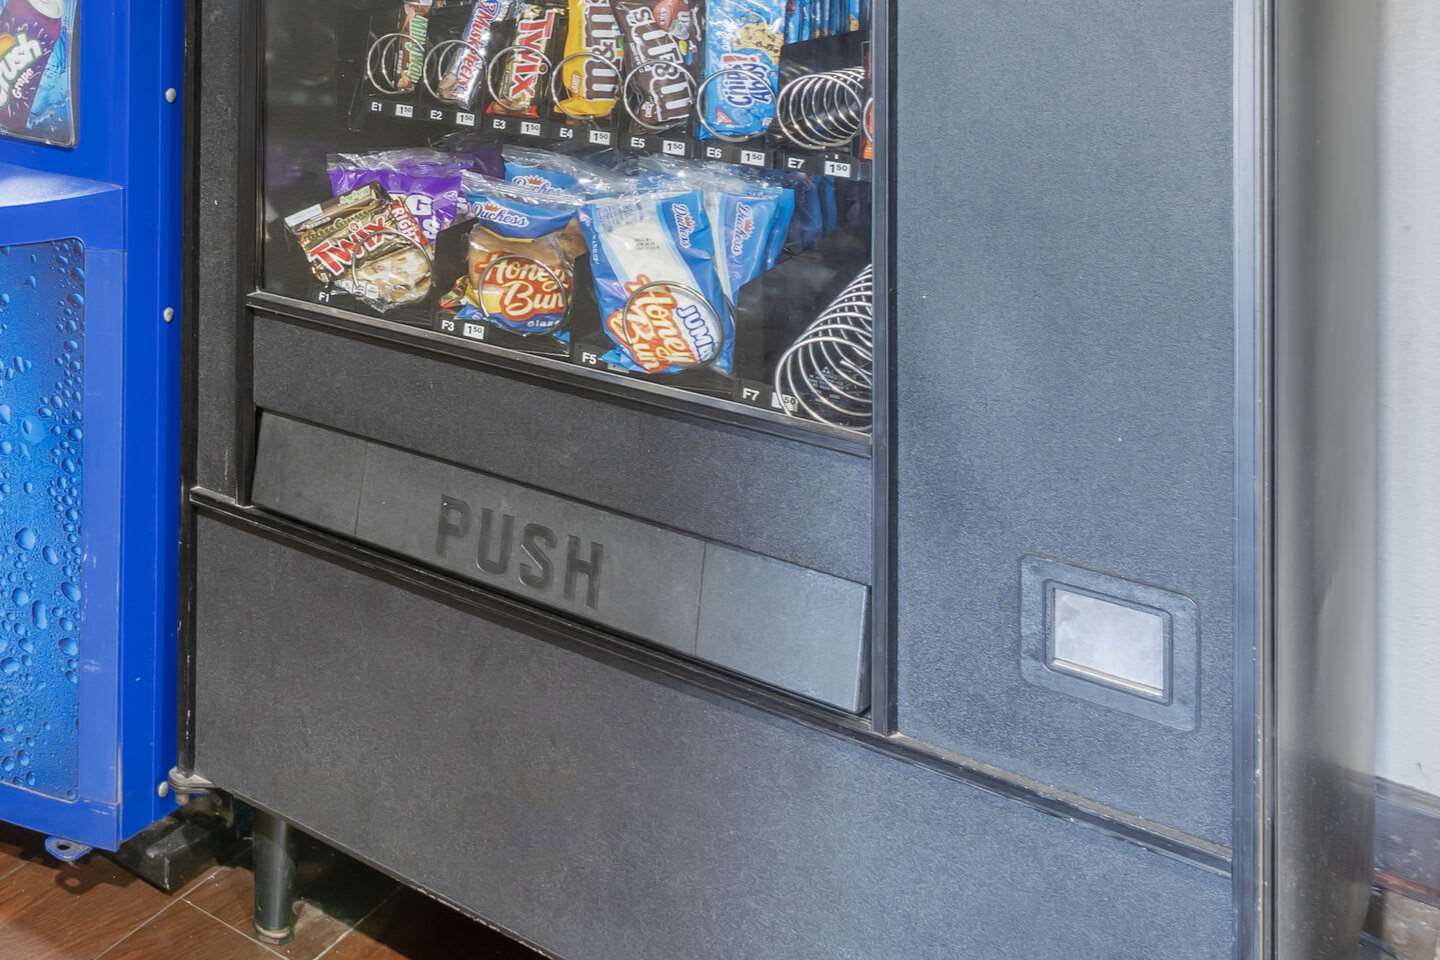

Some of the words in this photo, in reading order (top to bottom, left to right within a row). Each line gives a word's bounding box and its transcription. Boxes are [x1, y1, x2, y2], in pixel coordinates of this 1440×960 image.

[371, 102, 383, 112] E1
[430, 110, 443, 120] E2
[493, 119, 506, 129] E3
[560, 128, 574, 138] E4
[631, 137, 646, 148] E5
[706, 147, 723, 158] E6
[788, 158, 805, 169] E7
[478, 255, 570, 292] Honey
[318, 290, 330, 304] F1
[502, 280, 564, 317] Bun
[441, 320, 455, 333] F3
[582, 351, 597, 365] F5
[742, 387, 760, 400] F7
[436, 494, 605, 610] PUSH
